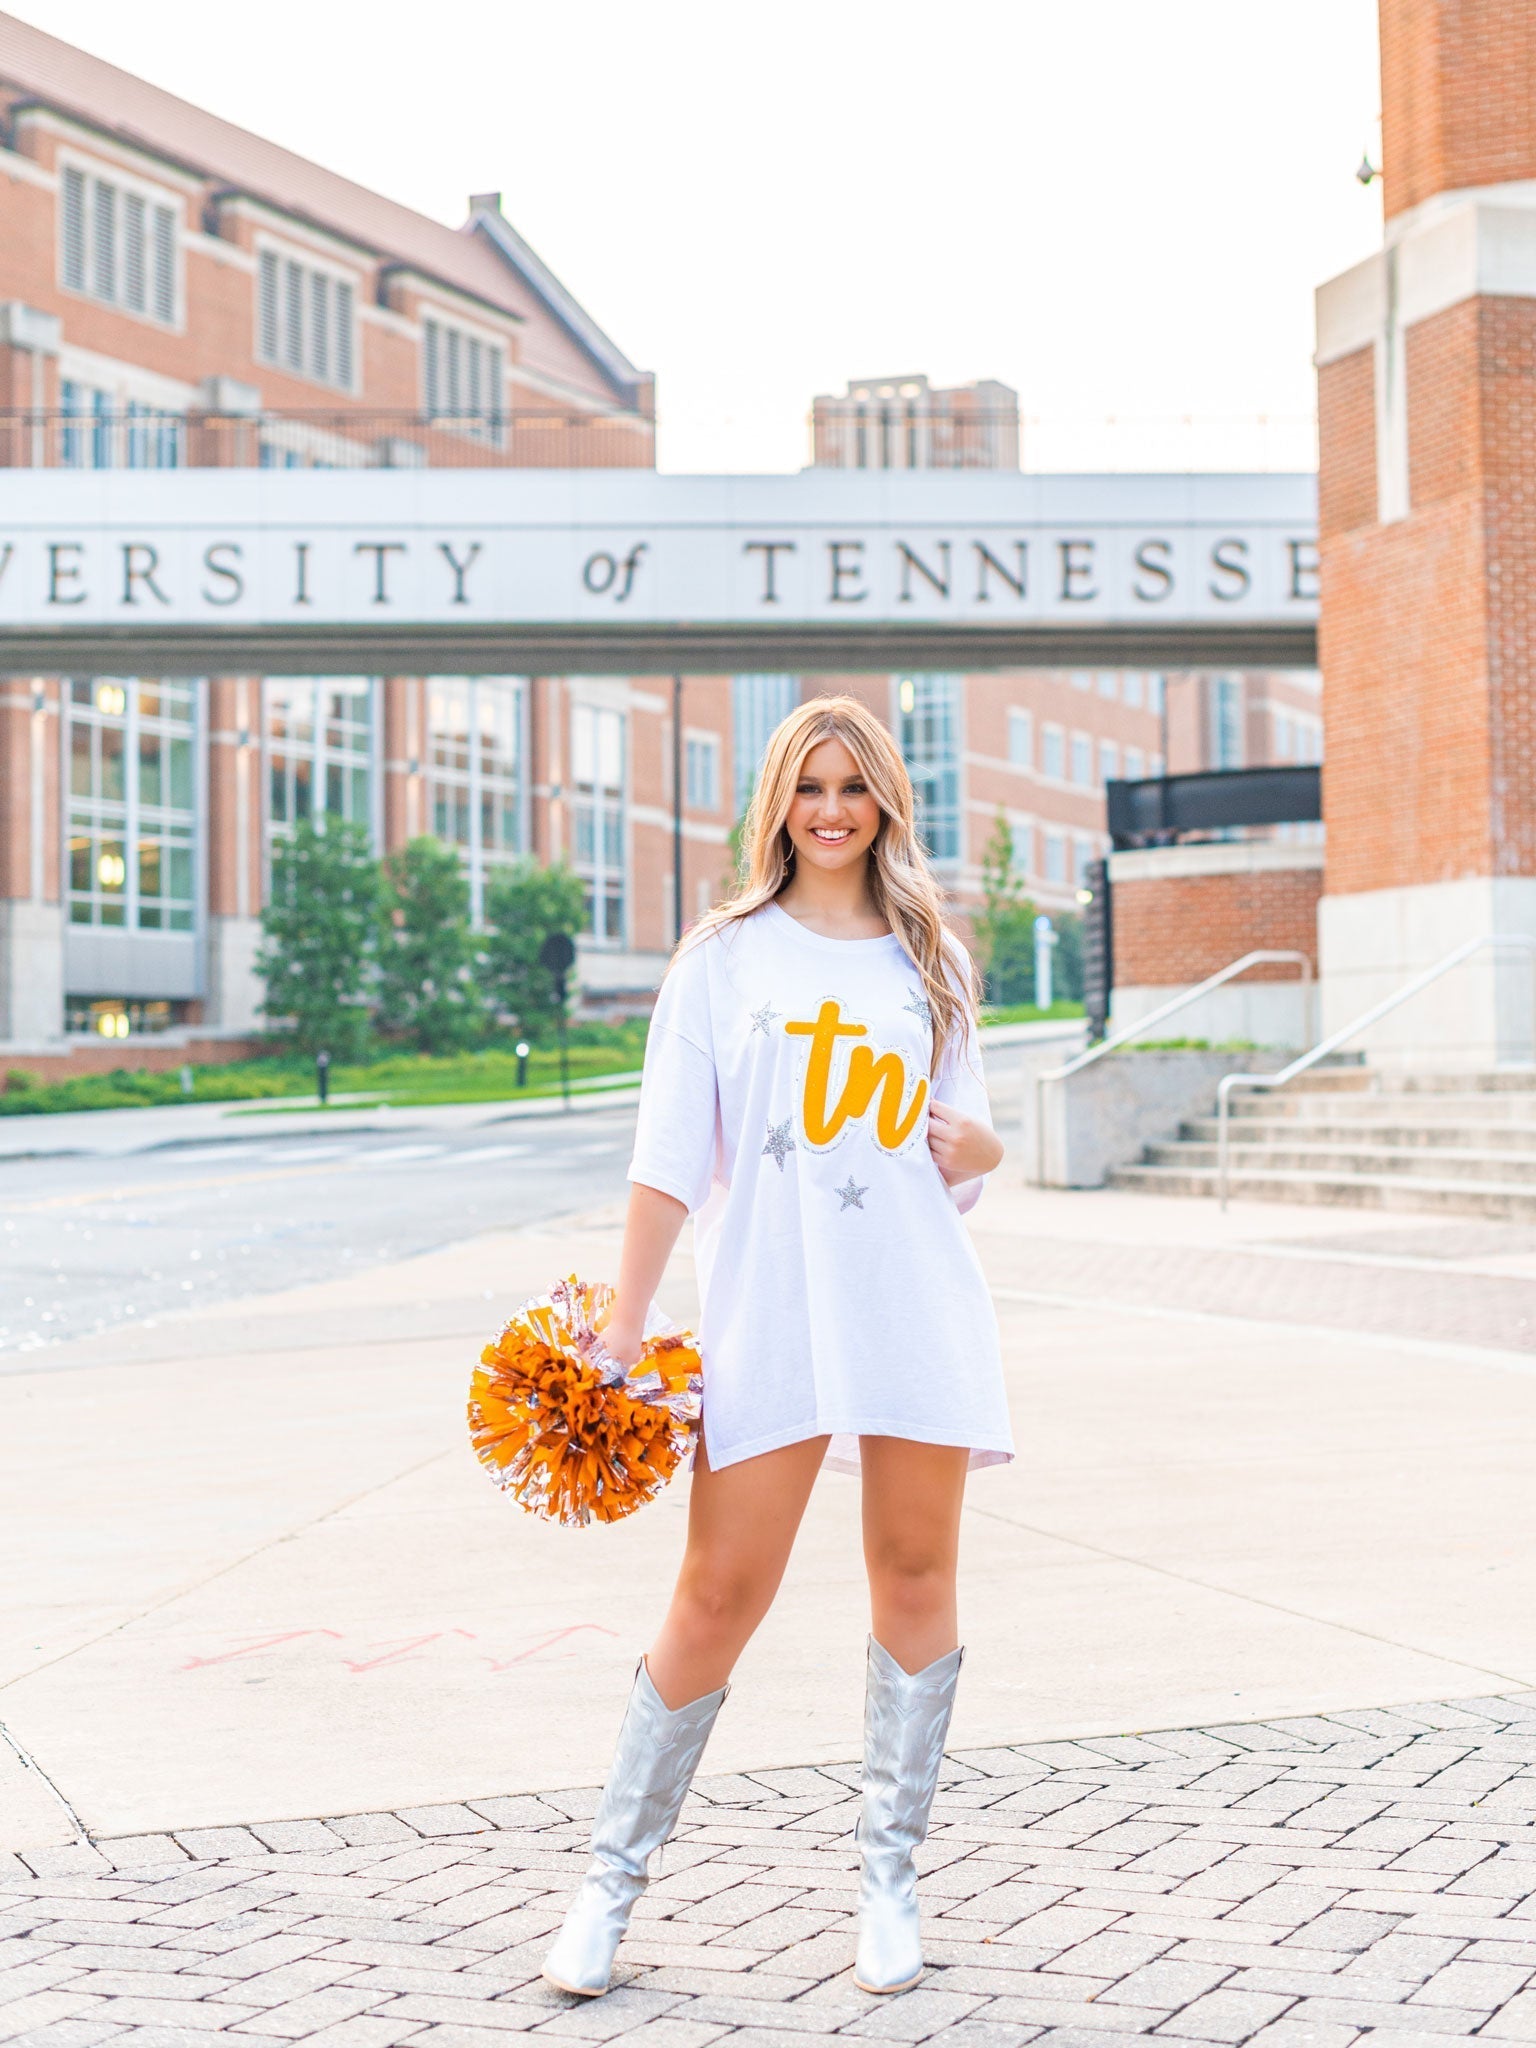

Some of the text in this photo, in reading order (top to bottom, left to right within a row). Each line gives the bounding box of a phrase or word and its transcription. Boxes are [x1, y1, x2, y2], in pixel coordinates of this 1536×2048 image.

[0, 541, 484, 604] ERSITY
[582, 541, 649, 603] of
[784, 1000, 928, 1149] tn
